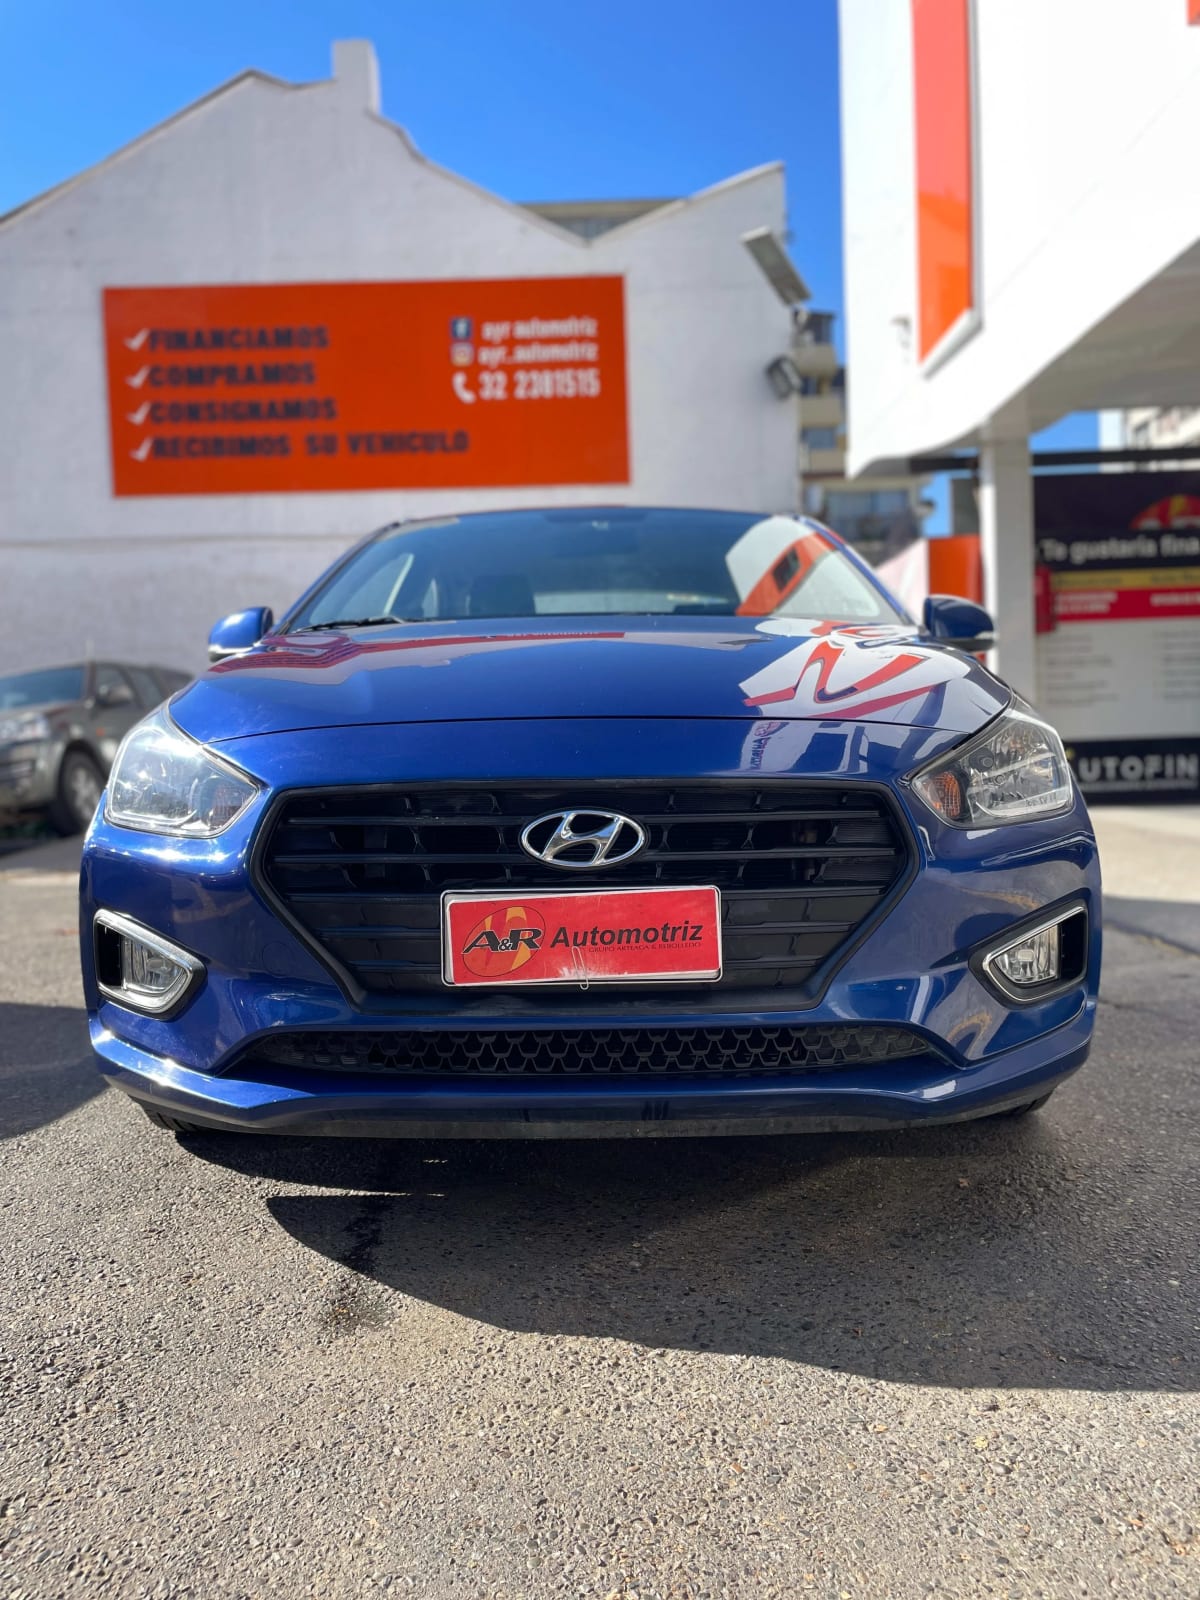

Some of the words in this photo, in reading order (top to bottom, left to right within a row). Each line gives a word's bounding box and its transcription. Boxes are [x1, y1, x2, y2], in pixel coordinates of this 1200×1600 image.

[150, 326, 329, 351] FINANCIAMOS
[481, 321, 511, 343] ayr
[513, 315, 598, 339] automotriz
[150, 363, 315, 388] COMPRAMOS
[478, 370, 507, 400] 32
[151, 398, 337, 423] CONSIGNAMOS
[153, 435, 291, 458] RECIBIMOS
[306, 433, 337, 455] SU
[347, 430, 469, 454] VEHICULO
[1040, 538, 1067, 561] Te
[1066, 754, 1198, 781] UTOFIN
[461, 928, 542, 954] A&R
[550, 920, 704, 948] Automotriz
